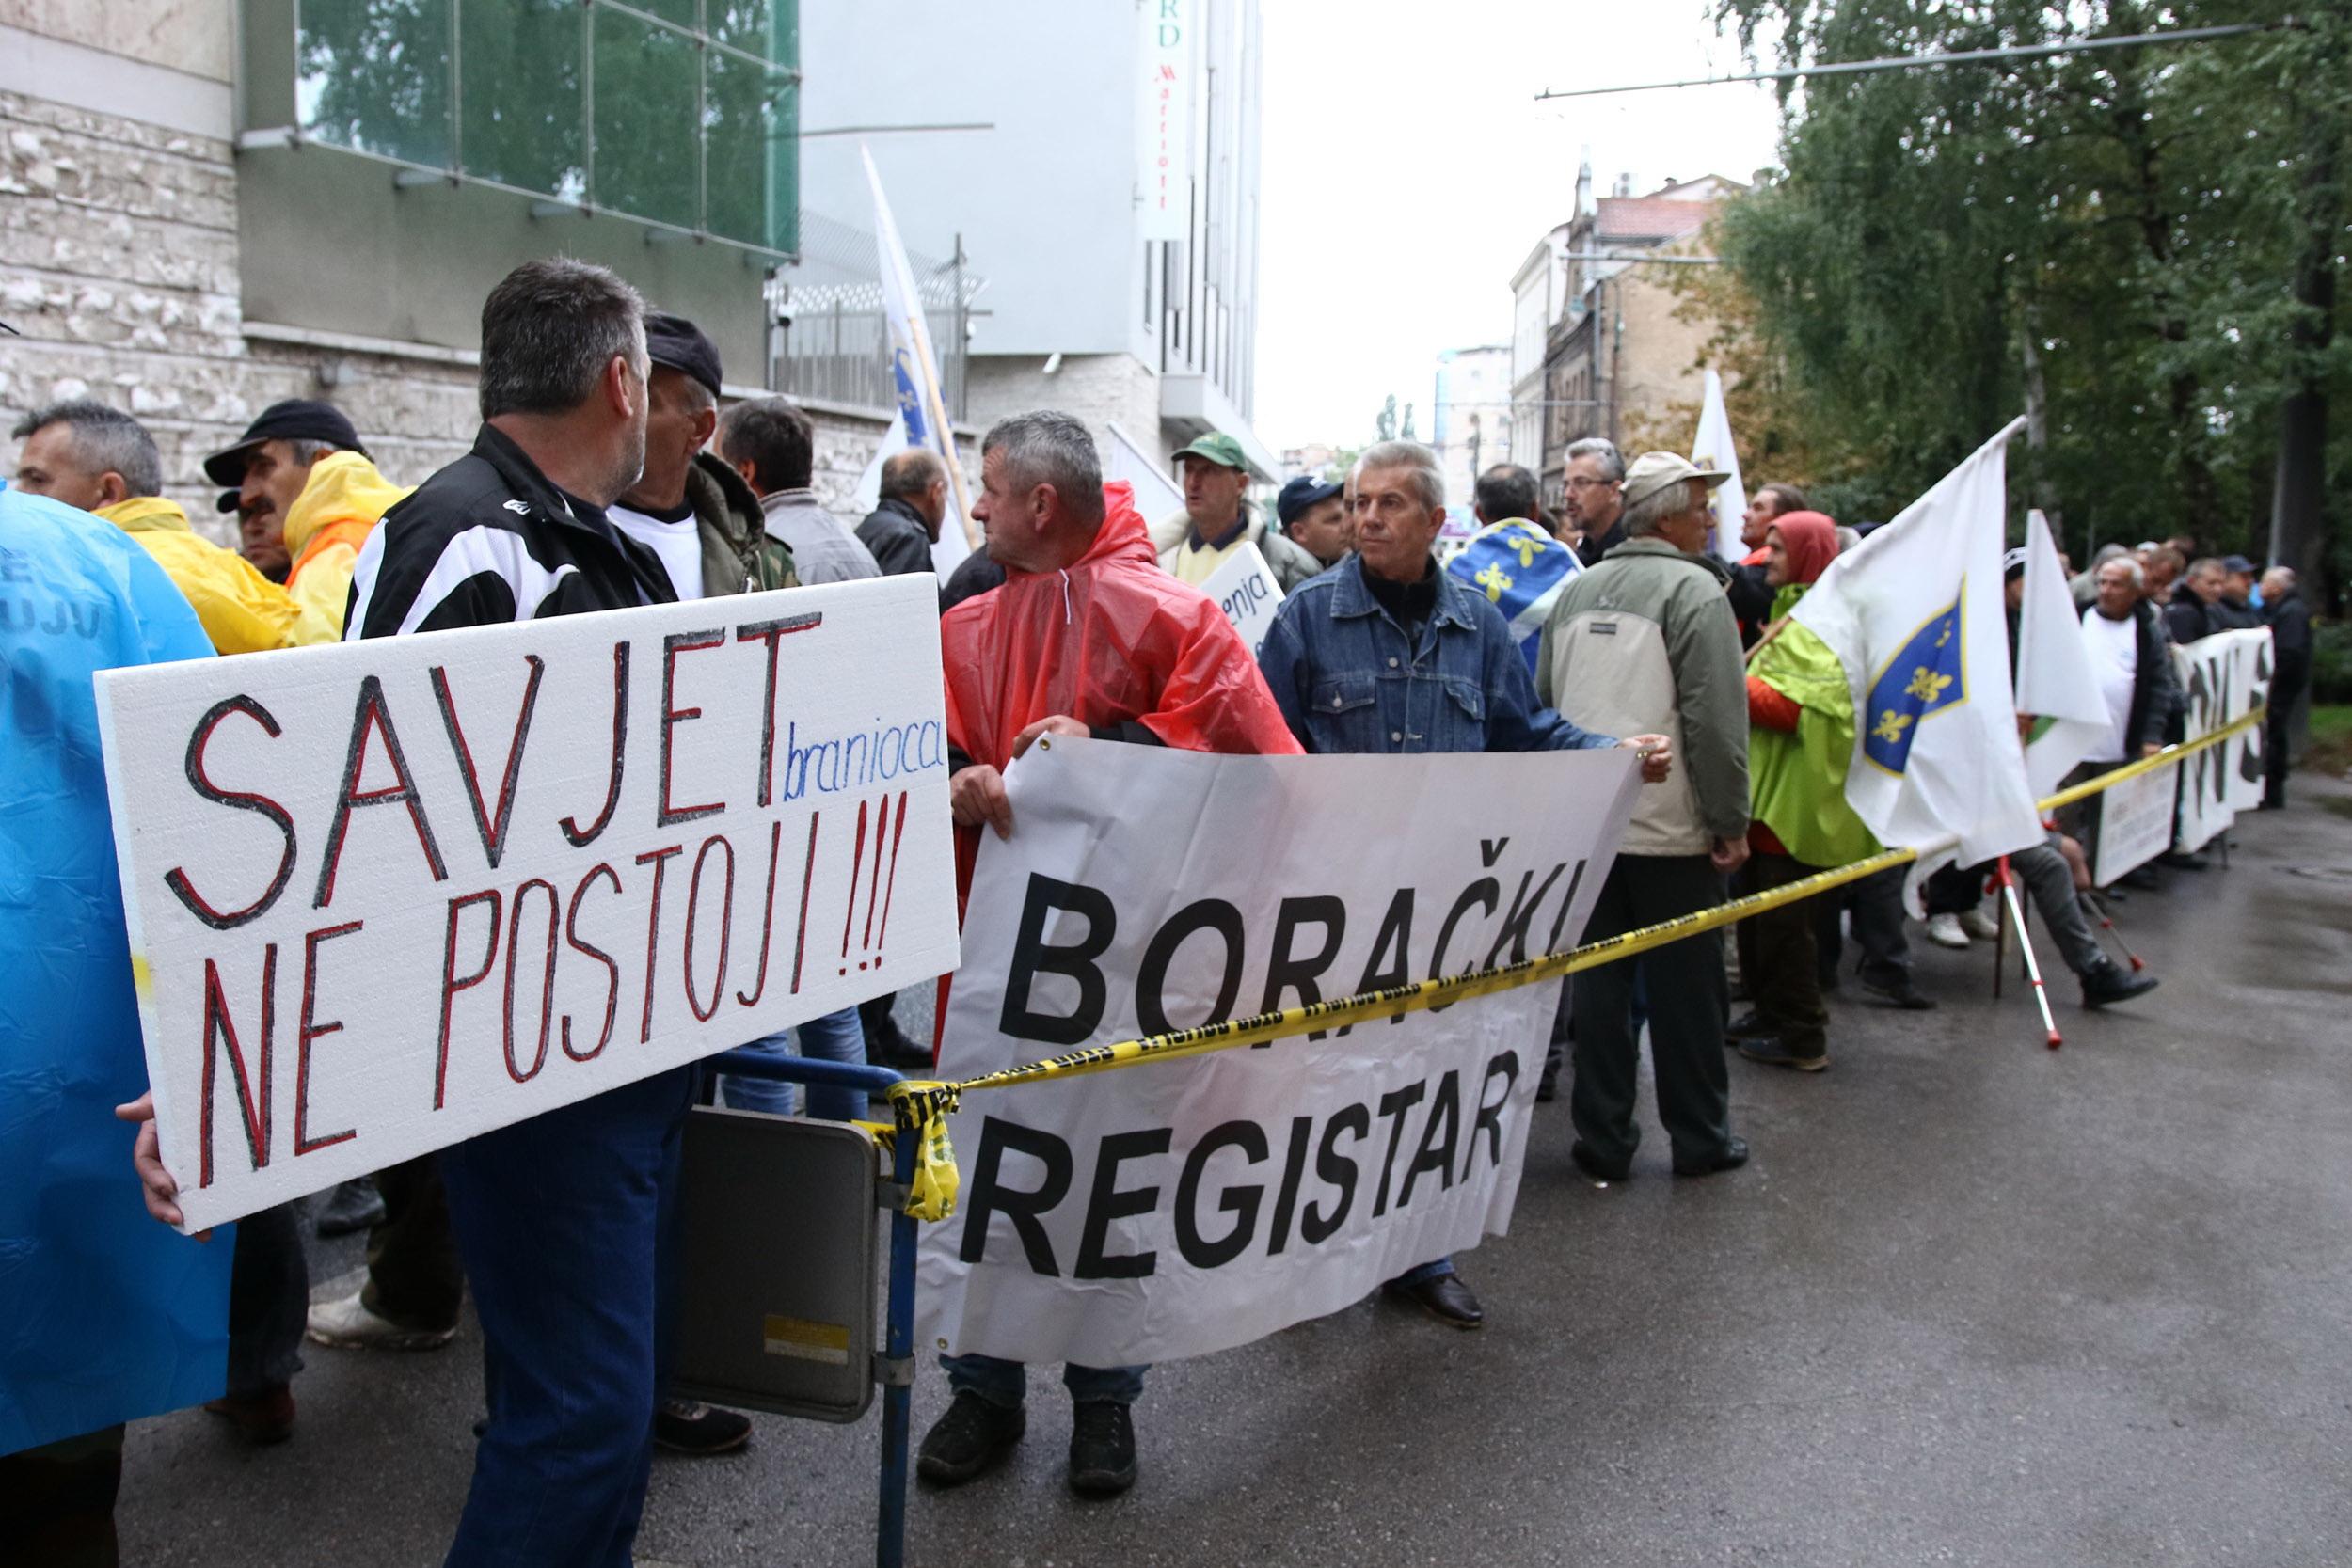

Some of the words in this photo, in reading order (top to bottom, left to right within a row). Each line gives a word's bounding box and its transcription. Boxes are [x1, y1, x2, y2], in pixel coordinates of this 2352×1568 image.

[164, 611, 823, 930] SAVJET
[783, 718, 944, 802] branioca
[199, 920, 363, 1188] NE
[998, 836, 1587, 1051] BORAČKI
[959, 1050, 1519, 1280] REGISTAR
